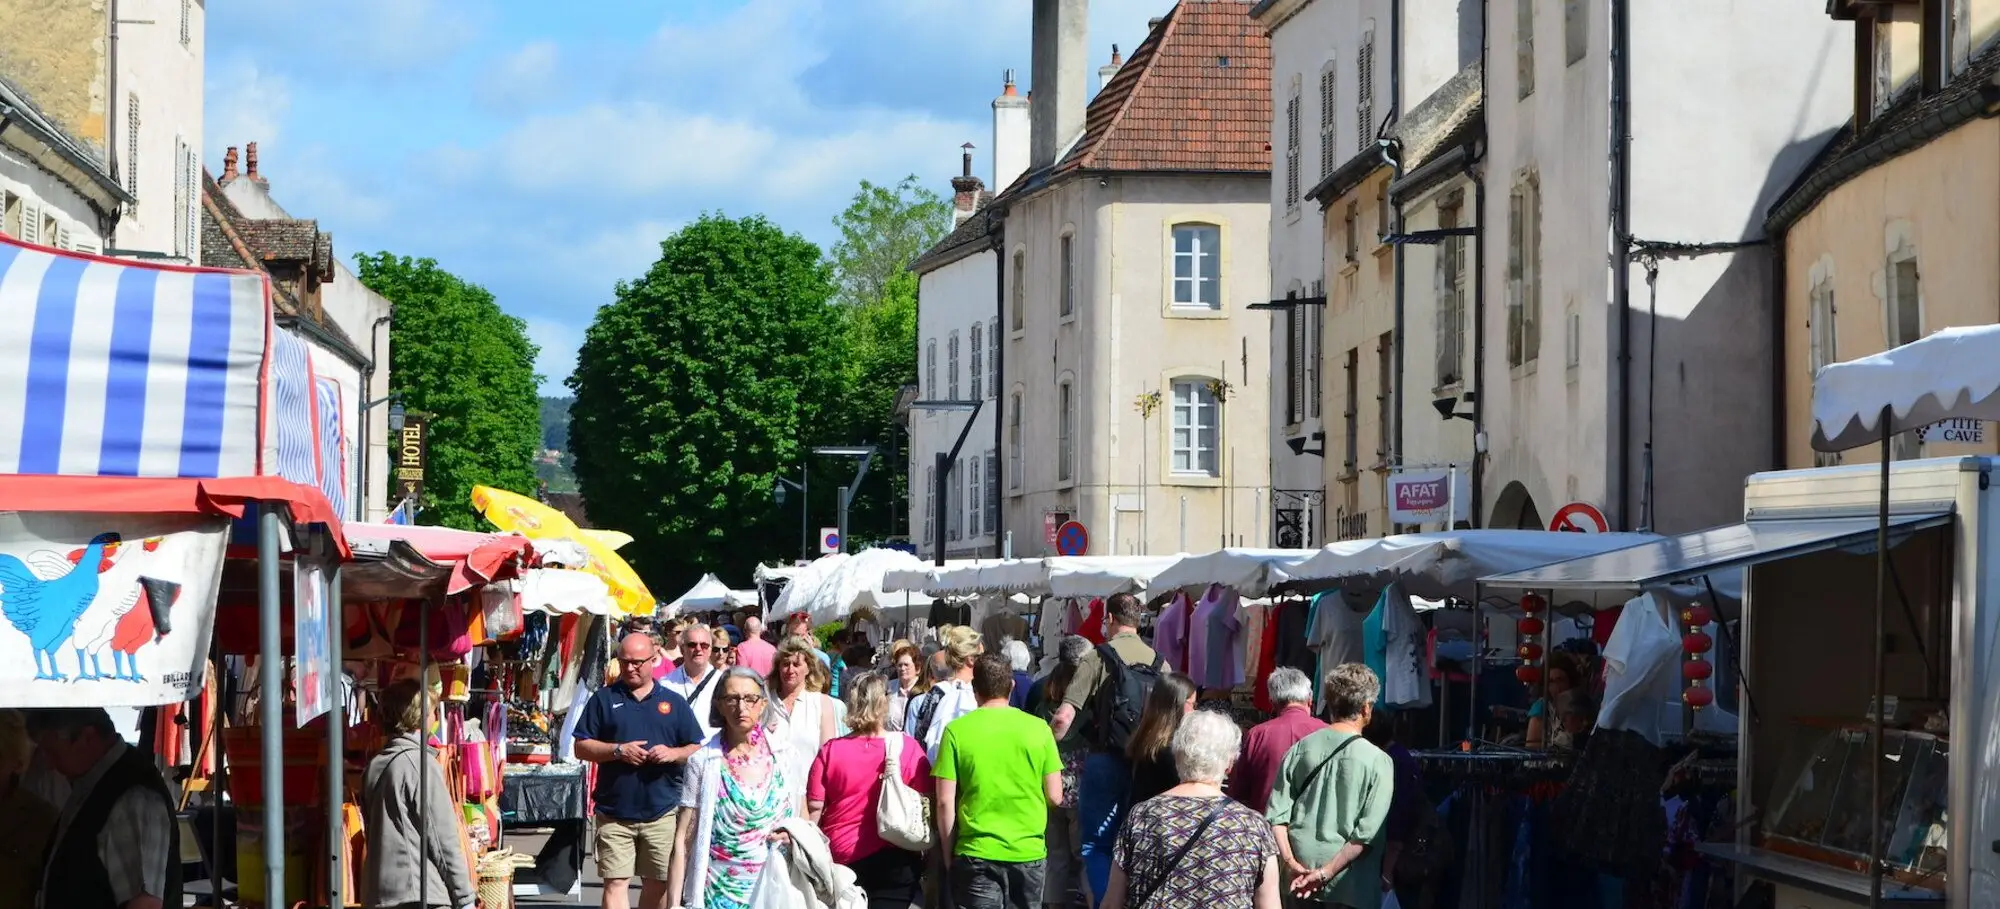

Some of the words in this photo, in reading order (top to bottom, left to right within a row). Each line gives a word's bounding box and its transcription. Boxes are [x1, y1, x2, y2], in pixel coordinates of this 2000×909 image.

[1944, 429, 1983, 442] CAVE
[402, 423, 420, 466] HOTEL
[1400, 483, 1439, 498] AFAT
